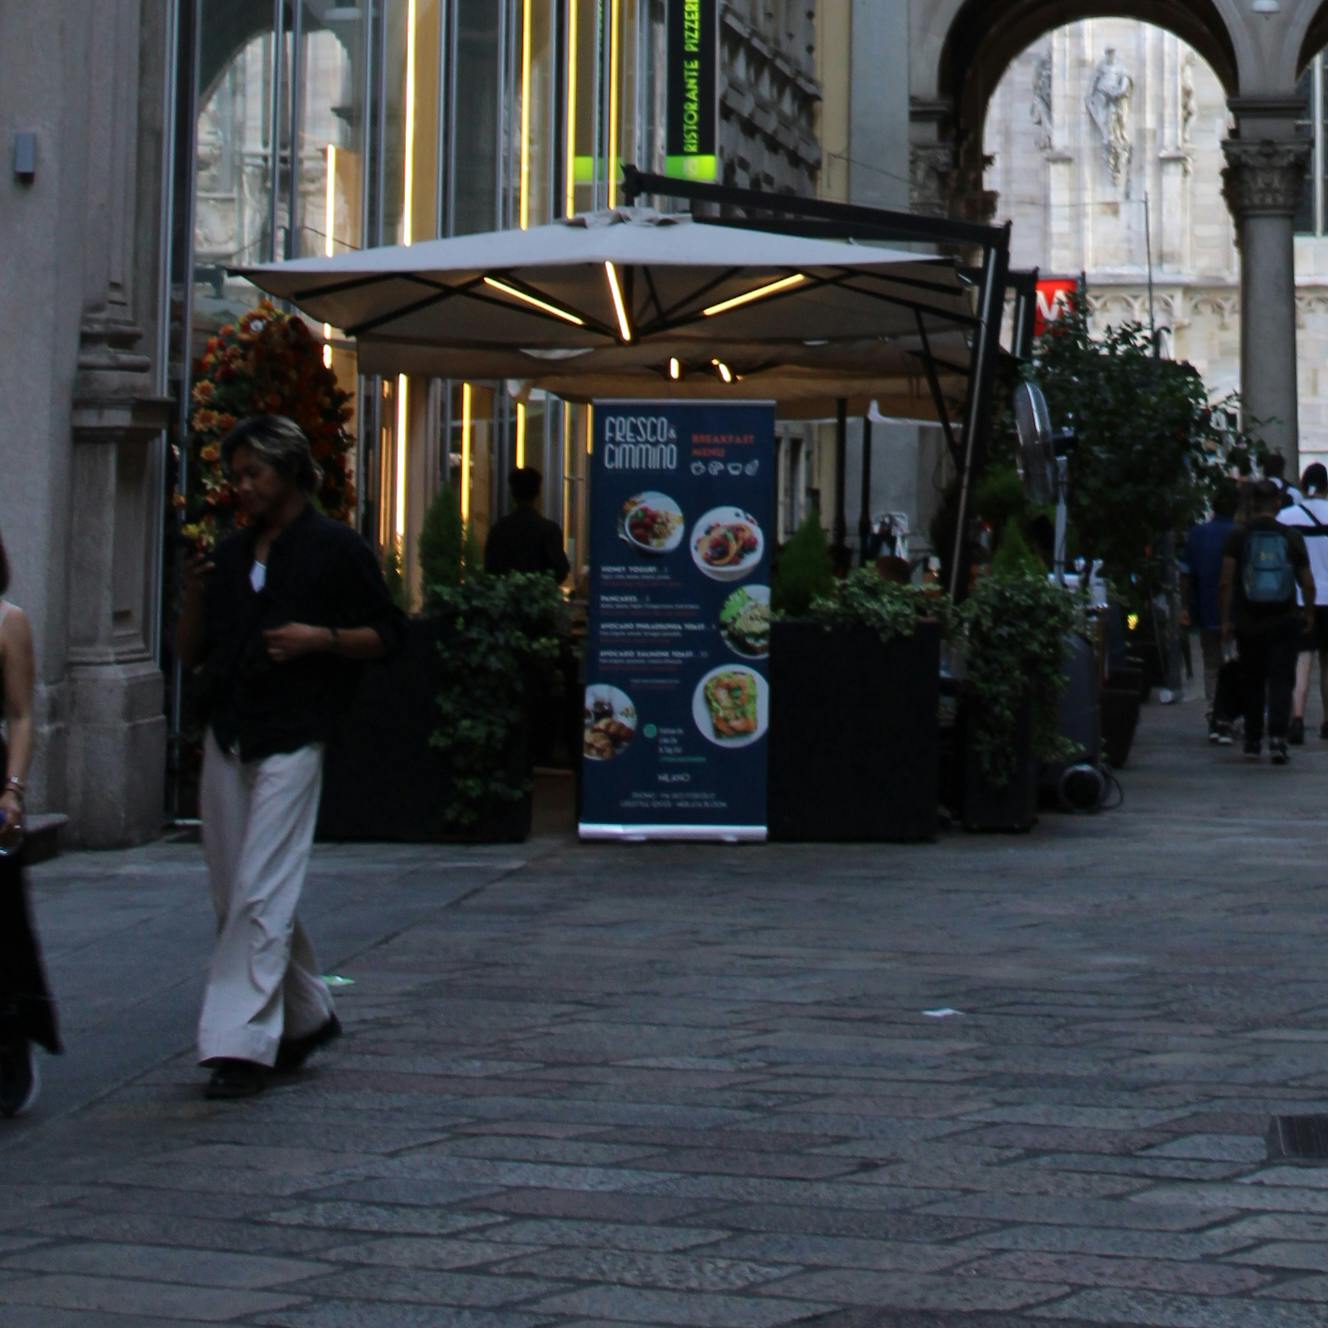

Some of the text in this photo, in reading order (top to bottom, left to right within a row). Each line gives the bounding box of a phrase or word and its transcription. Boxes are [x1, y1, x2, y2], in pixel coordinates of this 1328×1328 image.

[683, 59, 699, 153] RISTORANTE
[1035, 288, 1073, 322] M
[604, 416, 668, 443] FRESCO
[690, 433, 755, 445] BREAKFAST
[604, 443, 678, 470] CIMMINO
